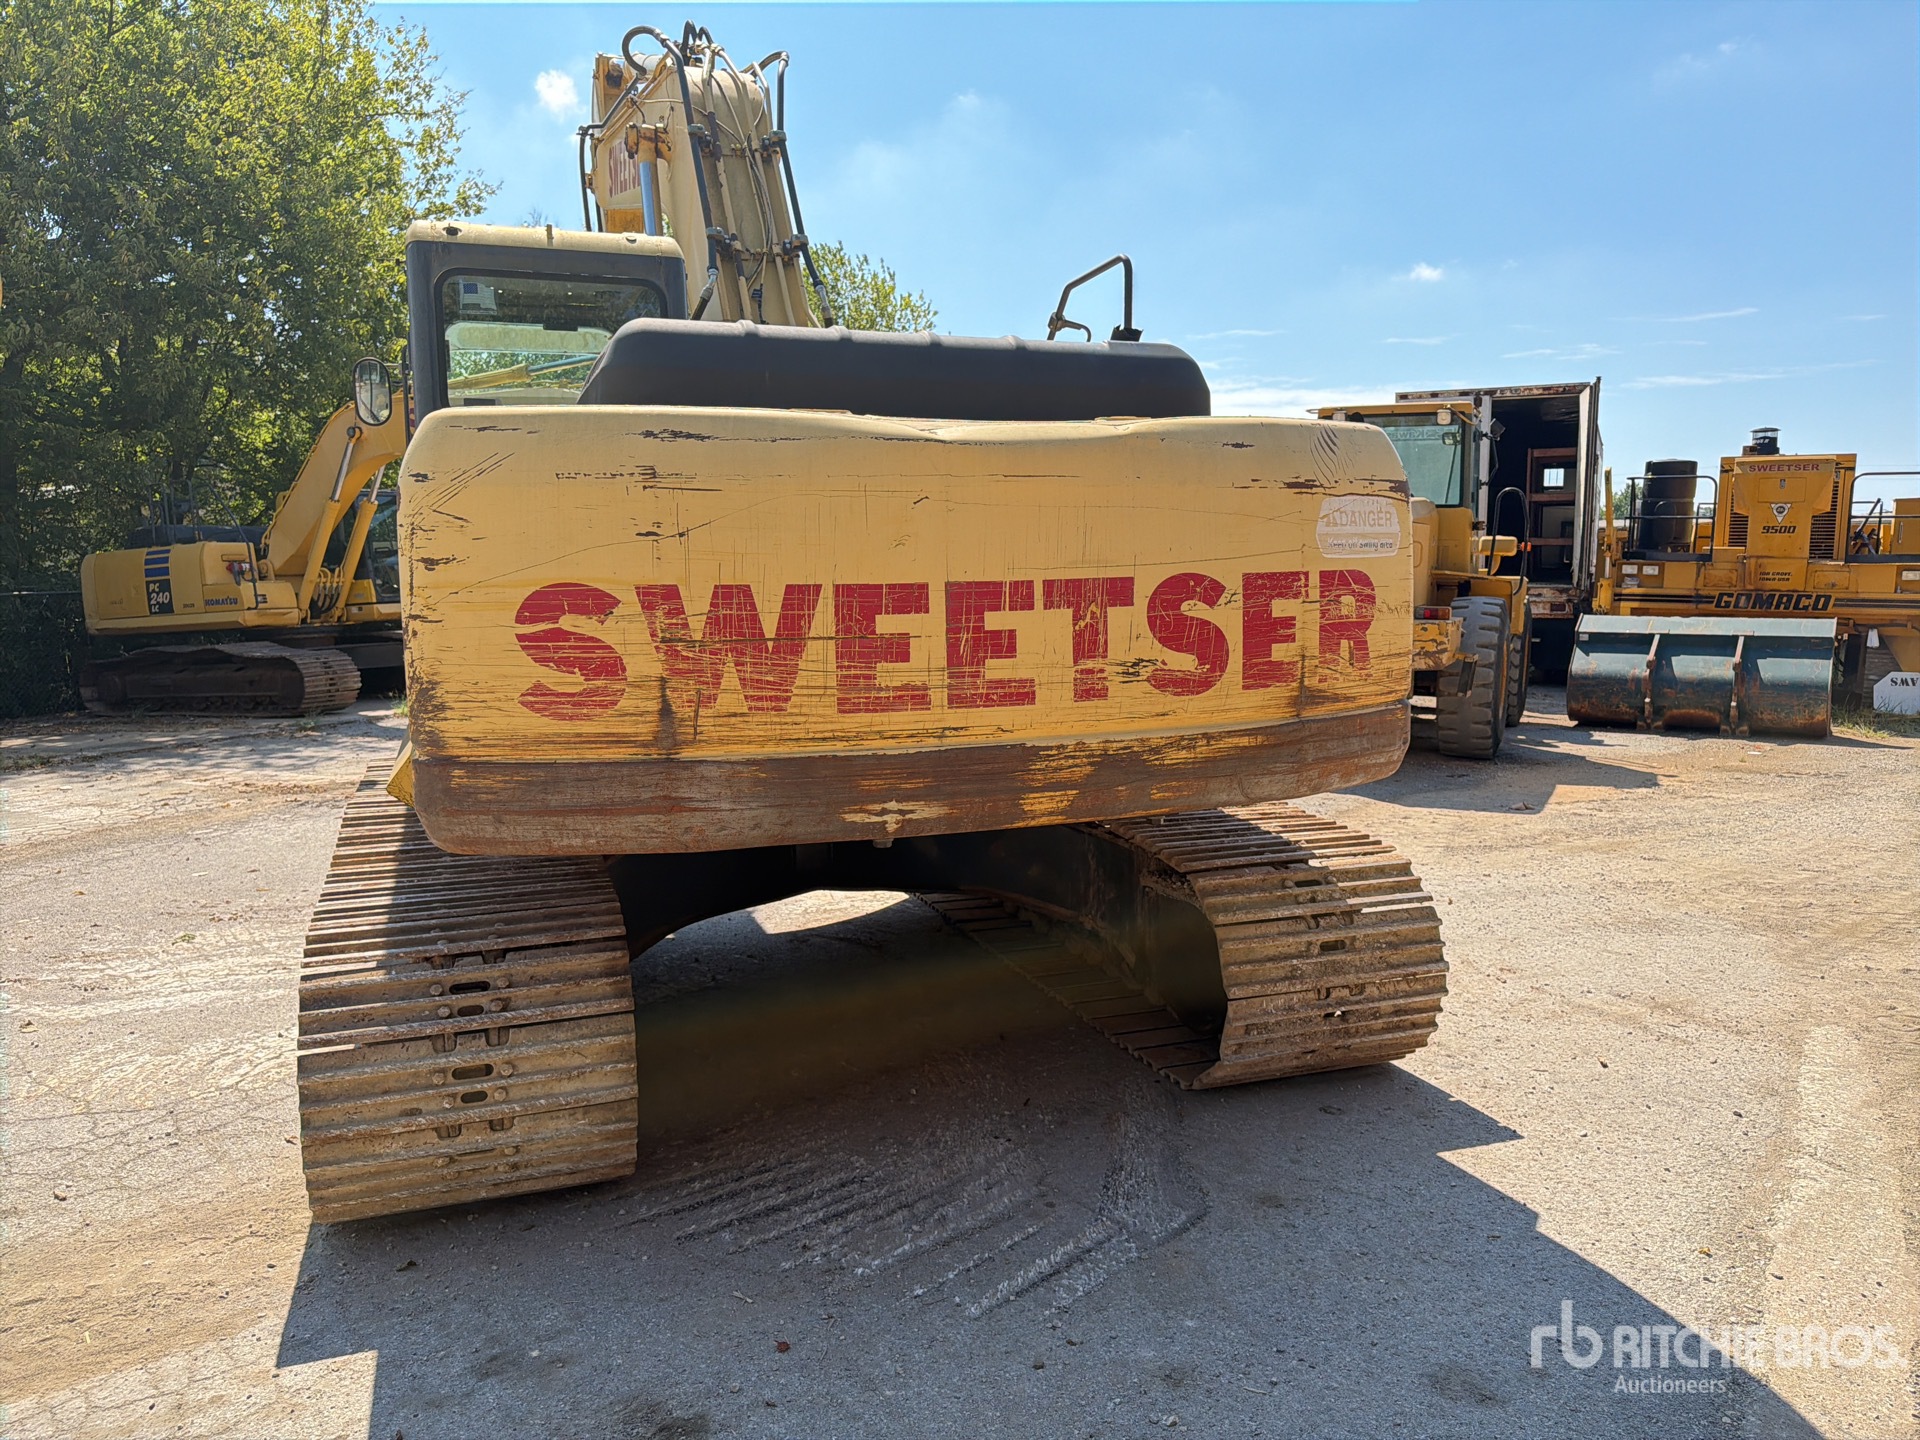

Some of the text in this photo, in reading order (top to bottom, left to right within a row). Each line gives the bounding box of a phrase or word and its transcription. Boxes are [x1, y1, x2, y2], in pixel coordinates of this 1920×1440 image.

[1749, 463, 1820, 473] SWEETSER
[1339, 510, 1392, 527] DANGER
[1761, 525, 1797, 534] 9500
[149, 583, 160, 592] PC
[150, 592, 170, 604] 240
[205, 595, 238, 606] KOMATSU
[1714, 592, 1832, 611] GOMACO
[152, 604, 160, 612] LC
[514, 569, 1377, 722] SWEETSER
